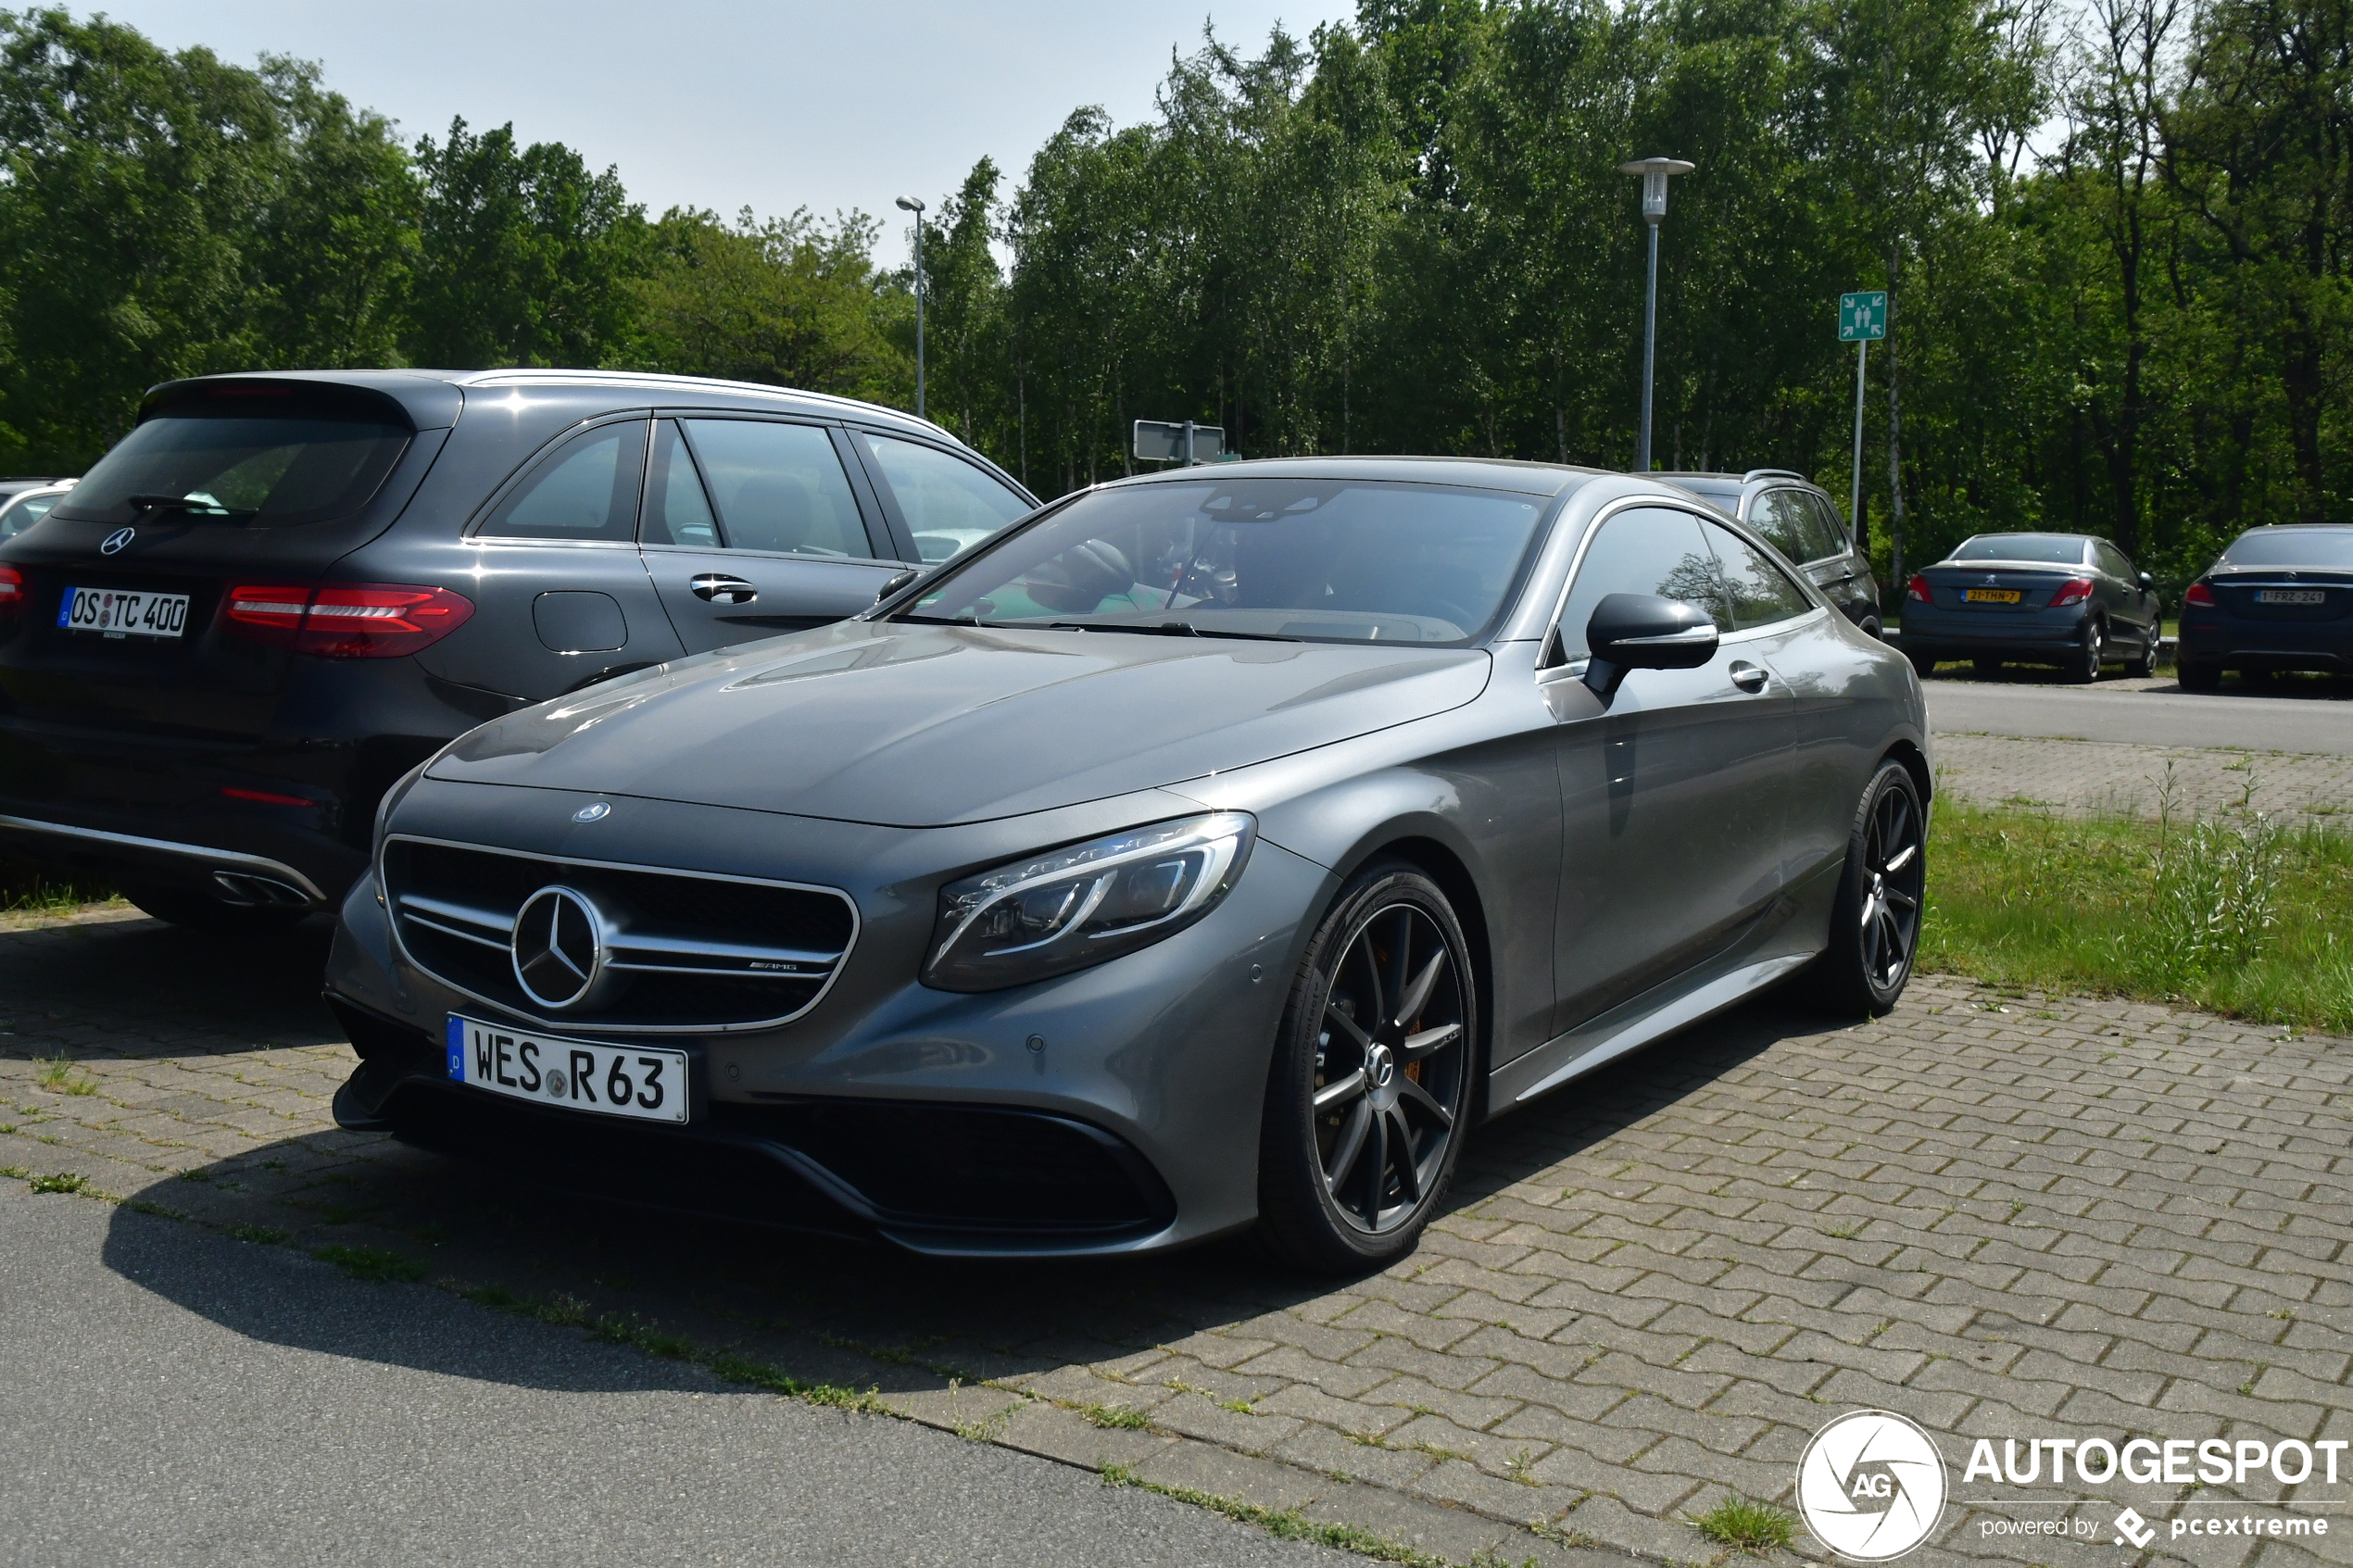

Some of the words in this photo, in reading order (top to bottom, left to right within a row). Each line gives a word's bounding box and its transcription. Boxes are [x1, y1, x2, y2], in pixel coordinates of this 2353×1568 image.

[1970, 591, 2016, 601] 21-THN-7
[71, 591, 100, 624] OS
[115, 595, 141, 627] TC
[144, 596, 186, 632] 400
[452, 1055, 460, 1070] D
[474, 1030, 541, 1092] WES
